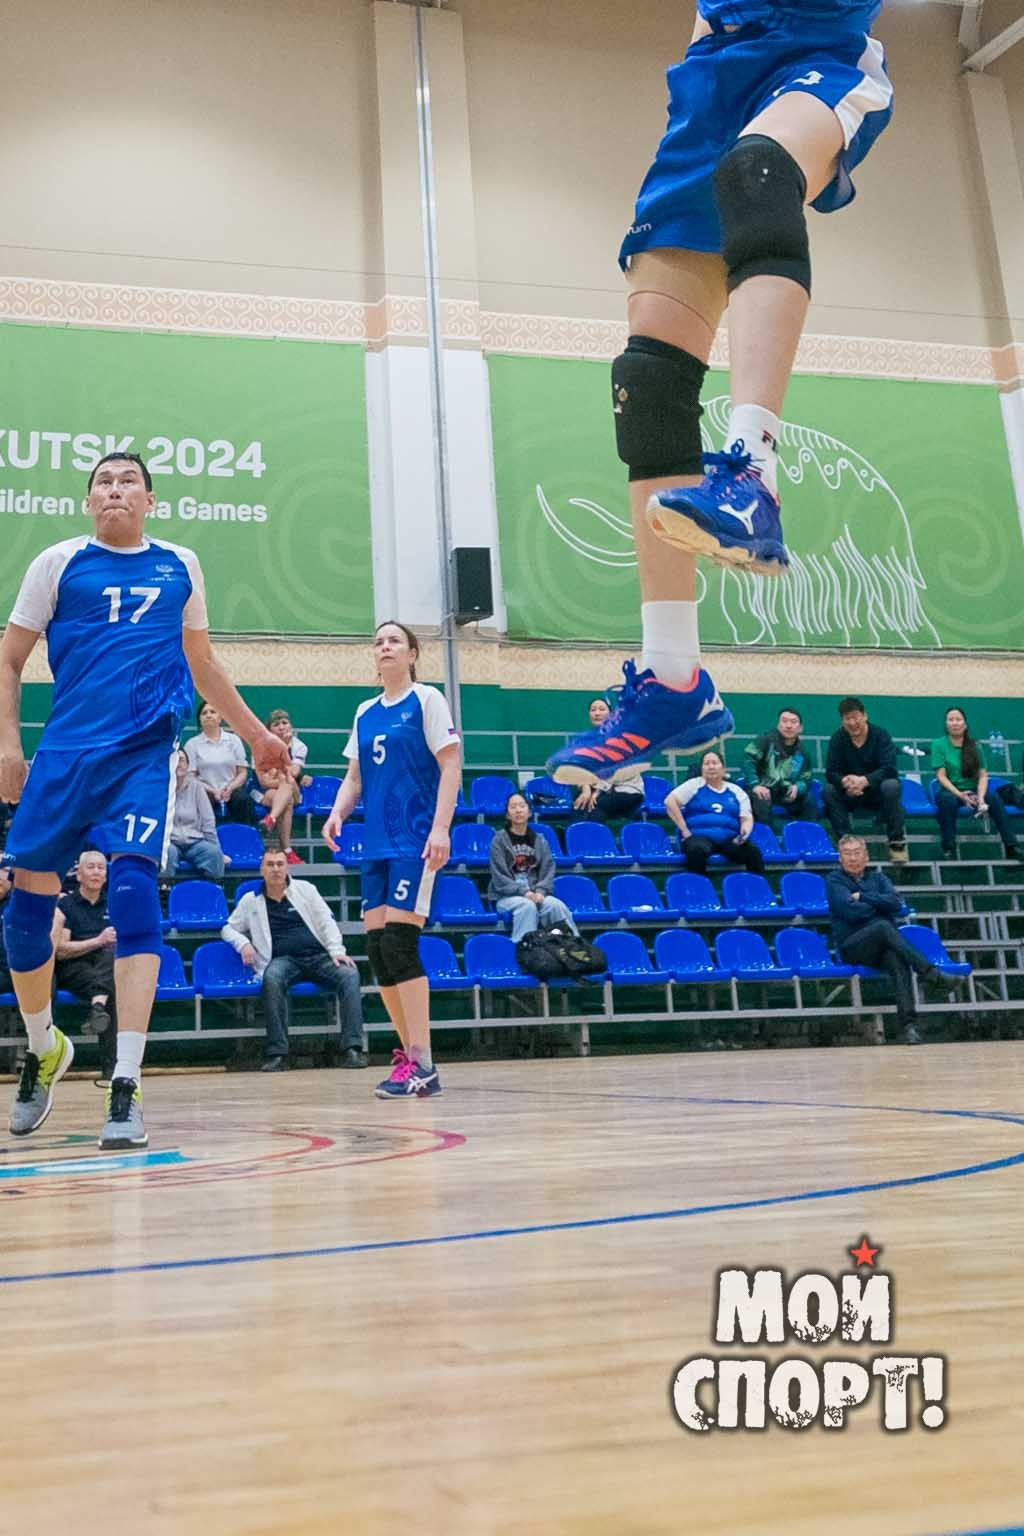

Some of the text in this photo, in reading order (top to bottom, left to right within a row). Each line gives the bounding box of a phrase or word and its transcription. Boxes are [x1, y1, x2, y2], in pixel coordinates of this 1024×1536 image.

[145, 436, 267, 478] 2024
[178, 495, 268, 523] Games
[102, 586, 161, 625] 17
[372, 734, 388, 765] 5
[124, 813, 159, 844] 17
[394, 878, 411, 901] 5
